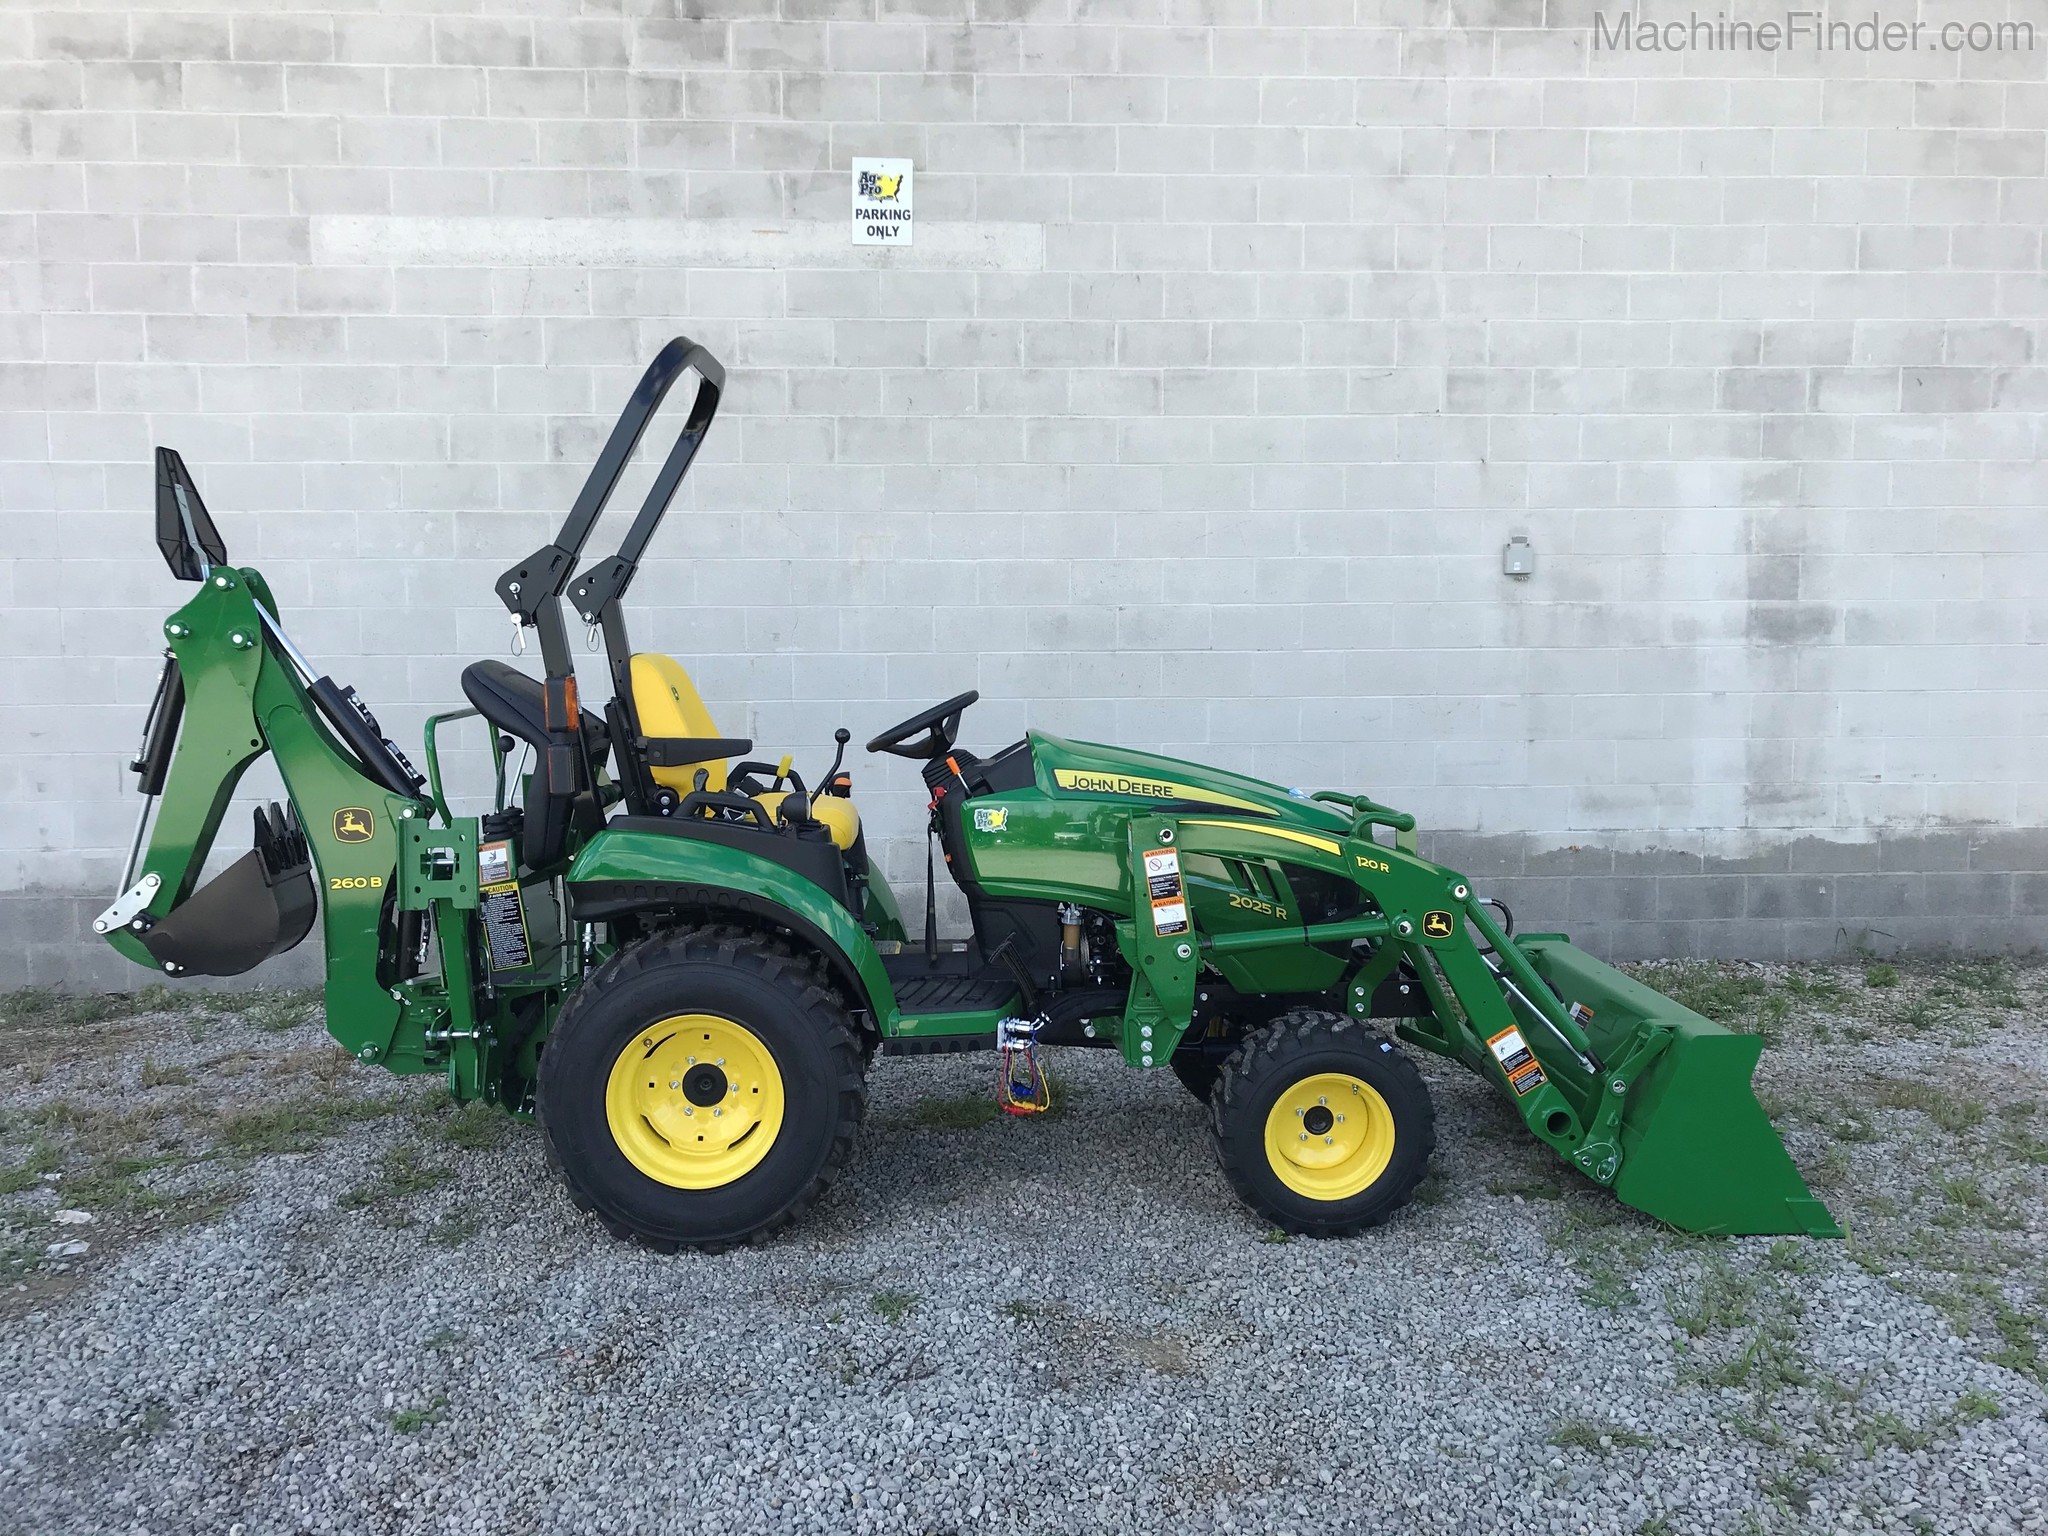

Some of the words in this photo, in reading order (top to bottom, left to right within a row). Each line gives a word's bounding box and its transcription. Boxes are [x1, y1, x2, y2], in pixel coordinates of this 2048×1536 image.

[859, 184, 881, 195] Pro
[855, 208, 911, 221] PARKING
[866, 225, 900, 237] ONLY
[1068, 775, 1114, 791] JOHN
[1118, 778, 1174, 797] DEERE
[977, 819, 992, 828] Pro
[1149, 848, 1176, 857] WARNING
[1356, 855, 1378, 870] 120
[1380, 862, 1390, 874] R
[330, 877, 368, 889] 260
[370, 876, 382, 888] B
[488, 884, 514, 893] CAUTION
[1157, 898, 1183, 908] WARNING
[1229, 893, 1272, 915] 2025
[1276, 906, 1288, 920] R
